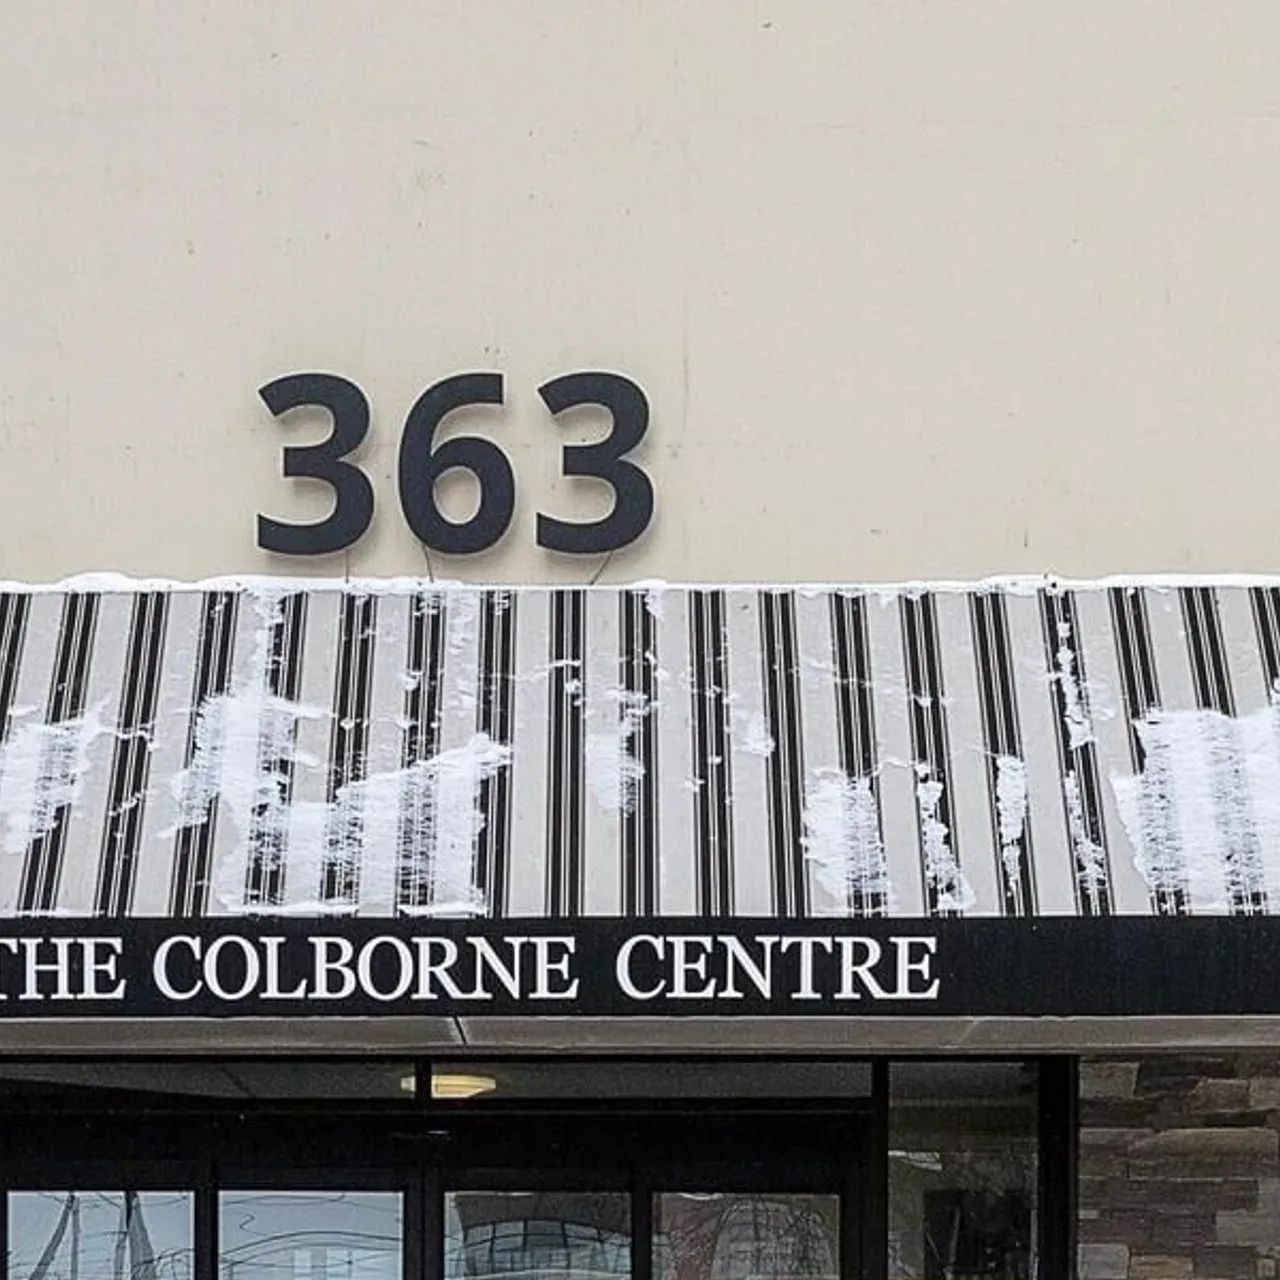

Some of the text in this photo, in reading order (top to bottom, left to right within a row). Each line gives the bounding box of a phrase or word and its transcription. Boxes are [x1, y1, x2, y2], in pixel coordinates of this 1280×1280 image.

[256, 371, 656, 556] 363
[152, 934, 580, 1000] COLBORNE
[616, 934, 941, 1000] CENTRE
